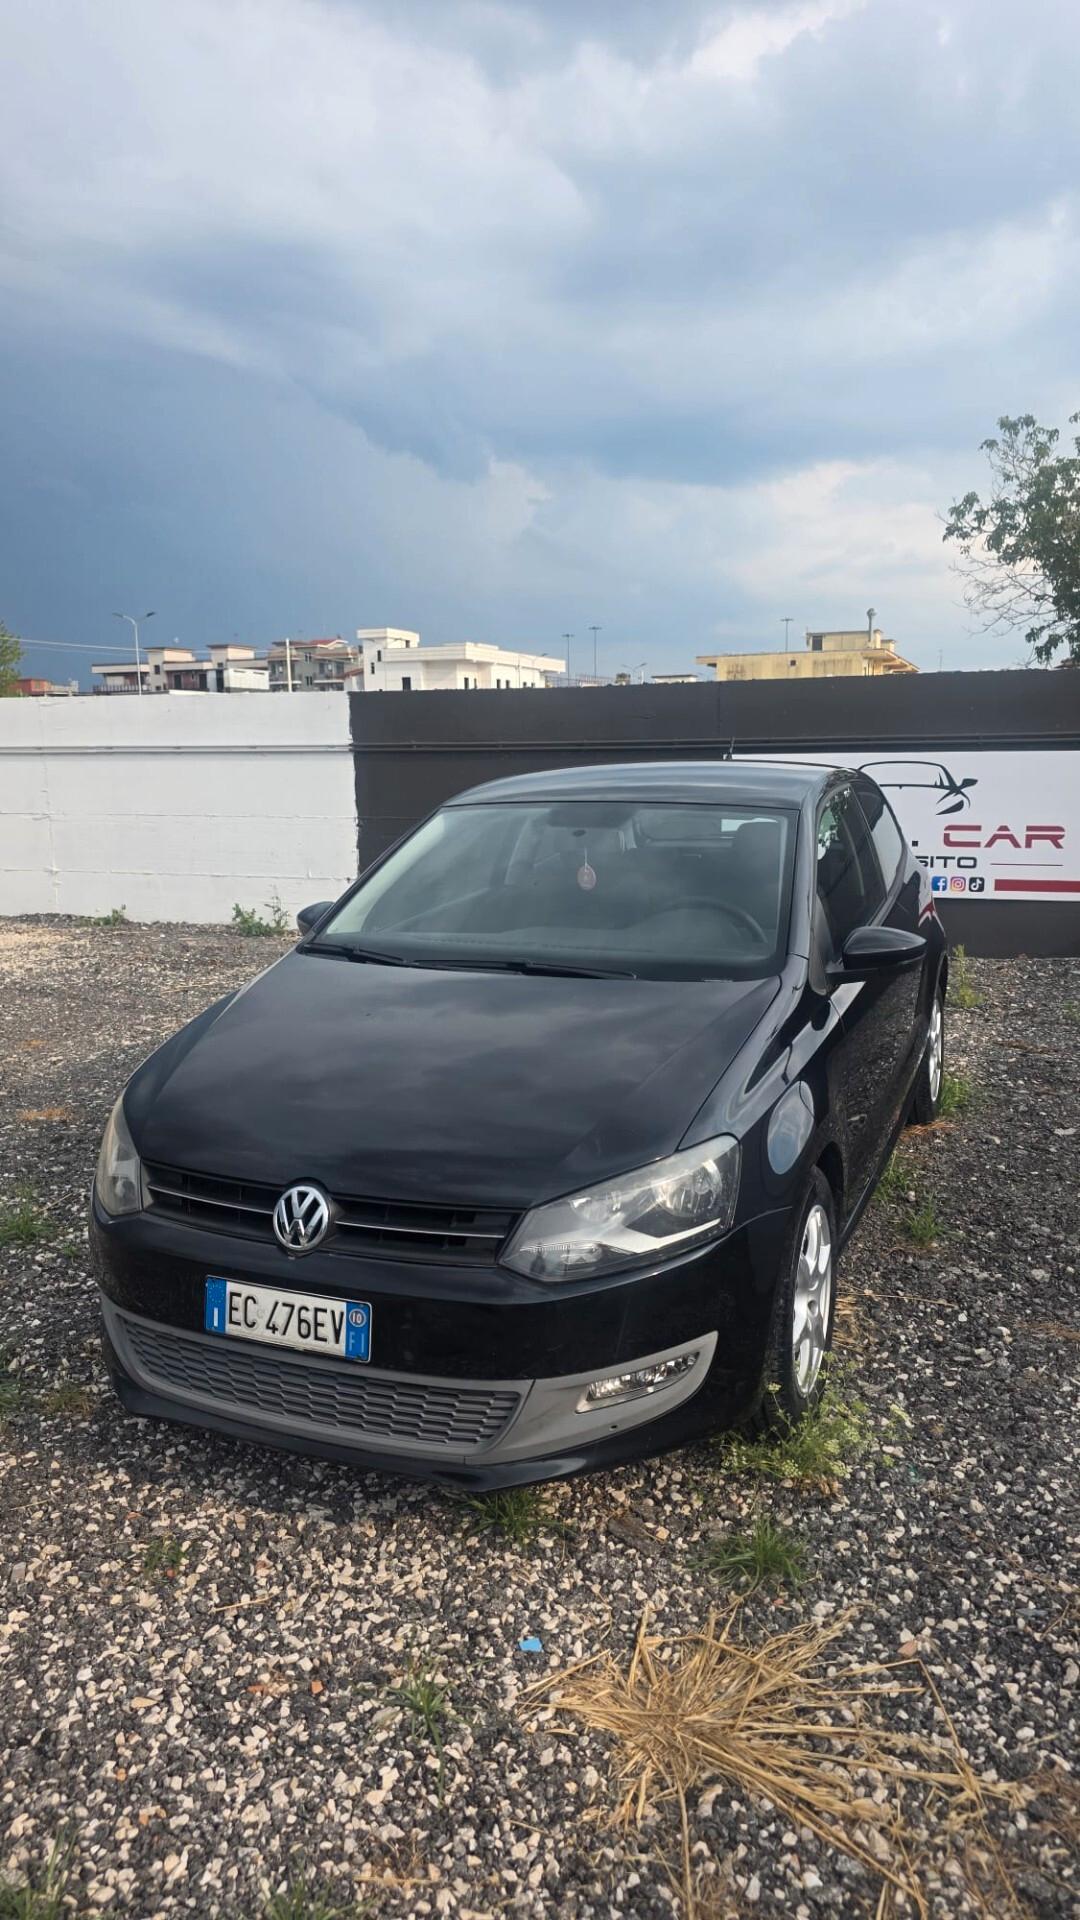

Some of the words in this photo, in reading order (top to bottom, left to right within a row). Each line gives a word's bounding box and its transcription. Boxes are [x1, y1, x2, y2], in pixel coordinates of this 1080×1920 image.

[943, 825, 1066, 849] CAR
[275, 1188, 327, 1248] VW
[228, 1292, 258, 1328] EC
[265, 1301, 345, 1345] 476EV
